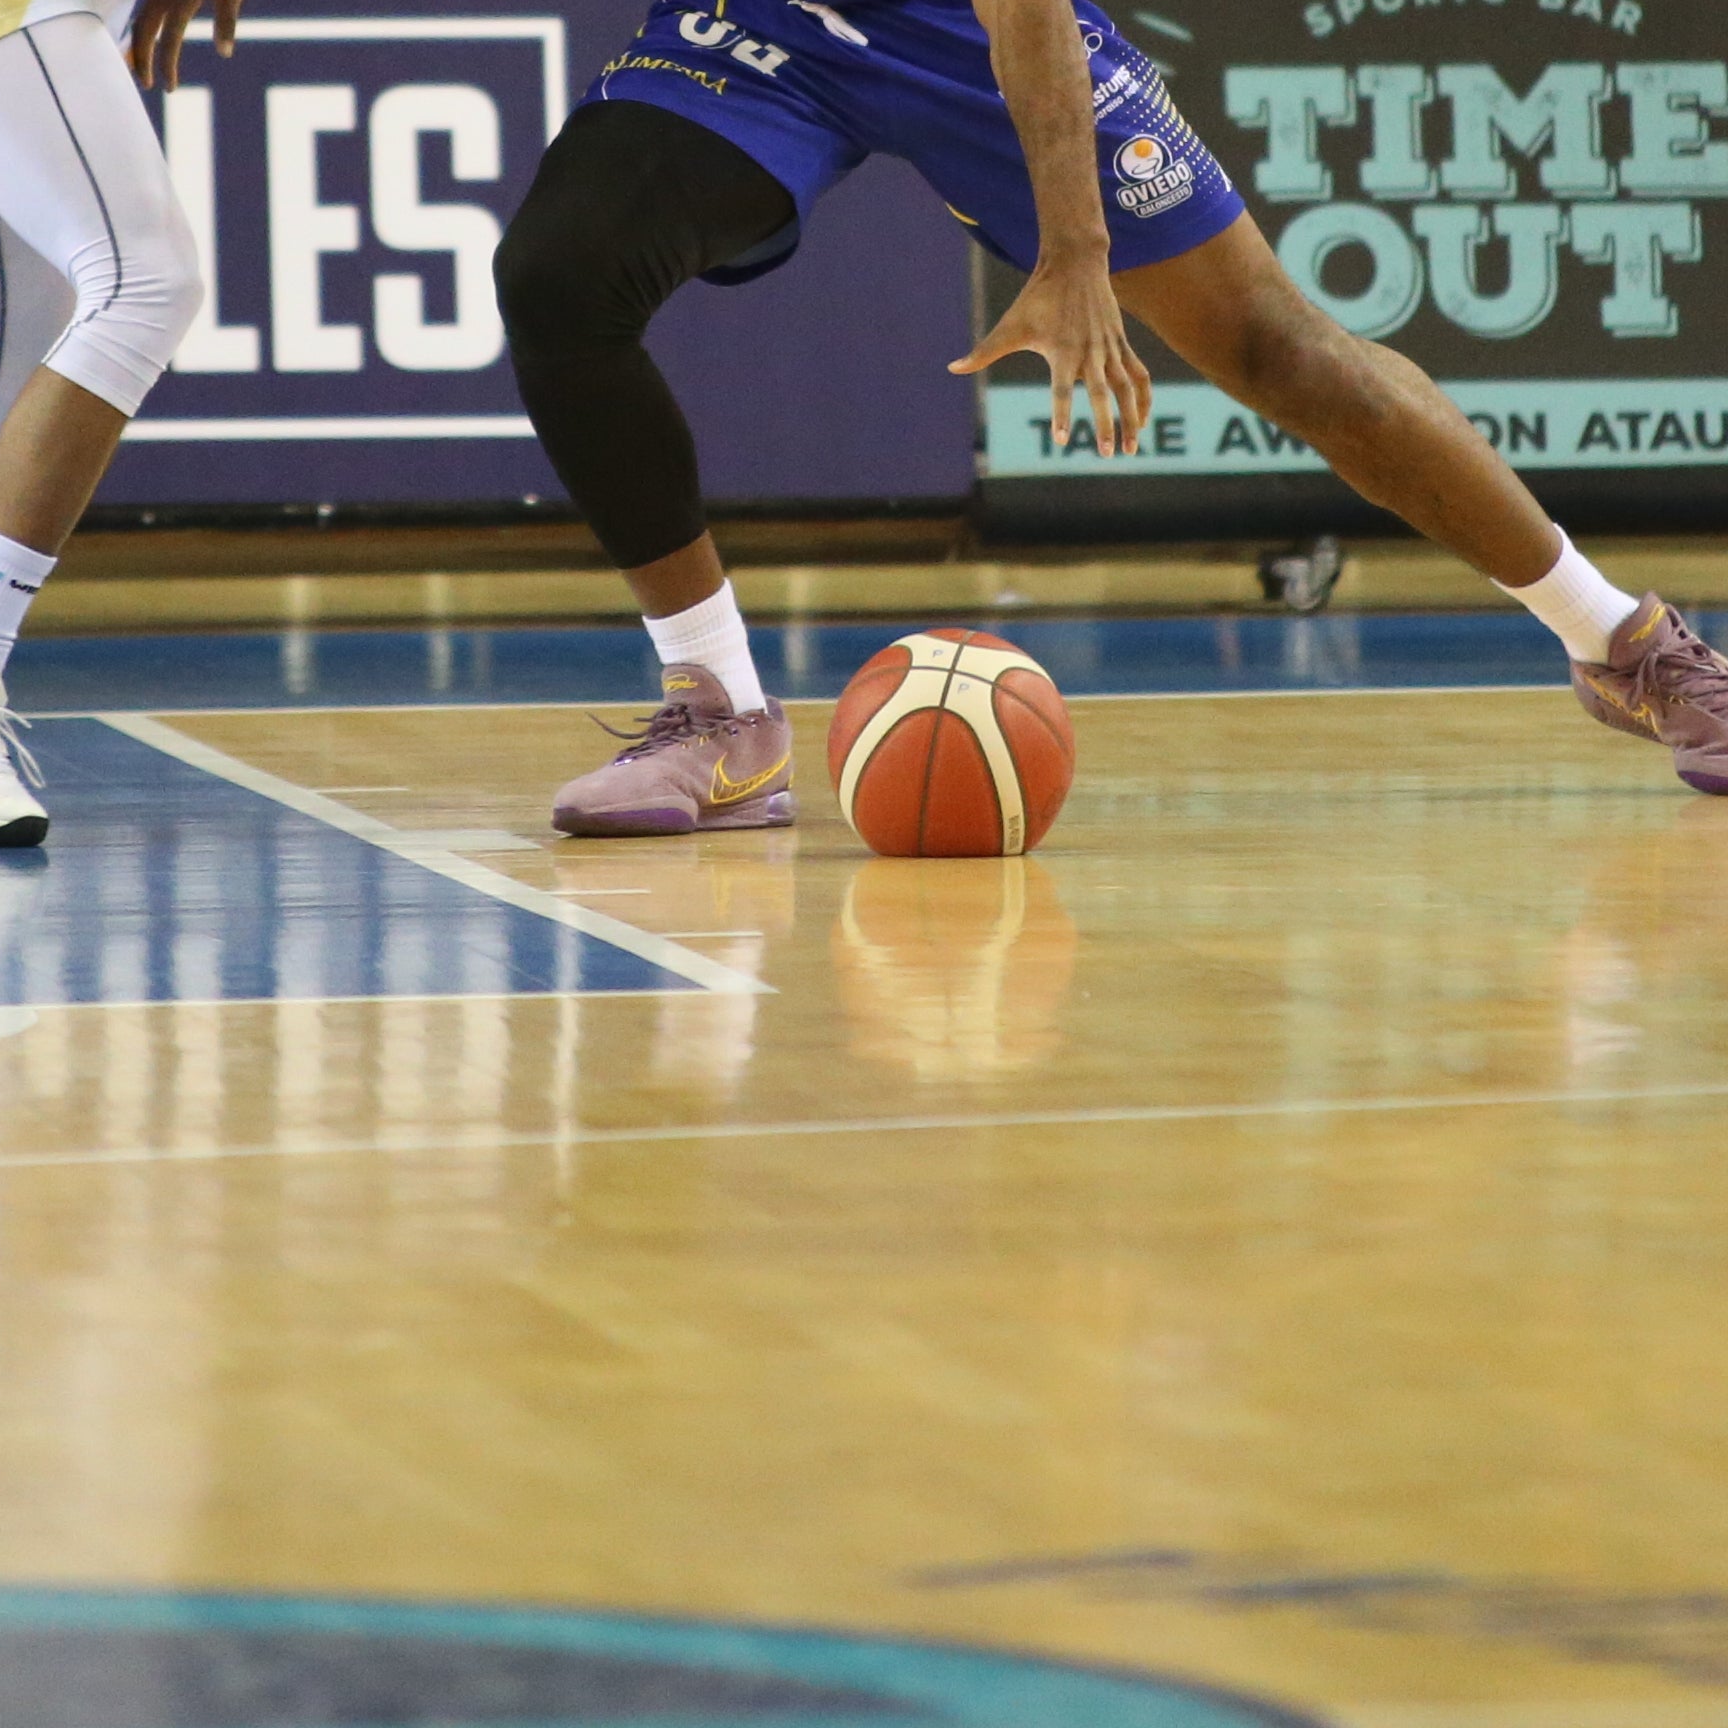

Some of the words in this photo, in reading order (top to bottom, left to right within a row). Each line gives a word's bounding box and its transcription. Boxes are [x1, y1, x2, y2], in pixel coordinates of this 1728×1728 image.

[1119, 161, 1191, 209] OVIEDO
[1139, 186, 1191, 216] BALONCESTO
[1274, 202, 1703, 341] OUT
